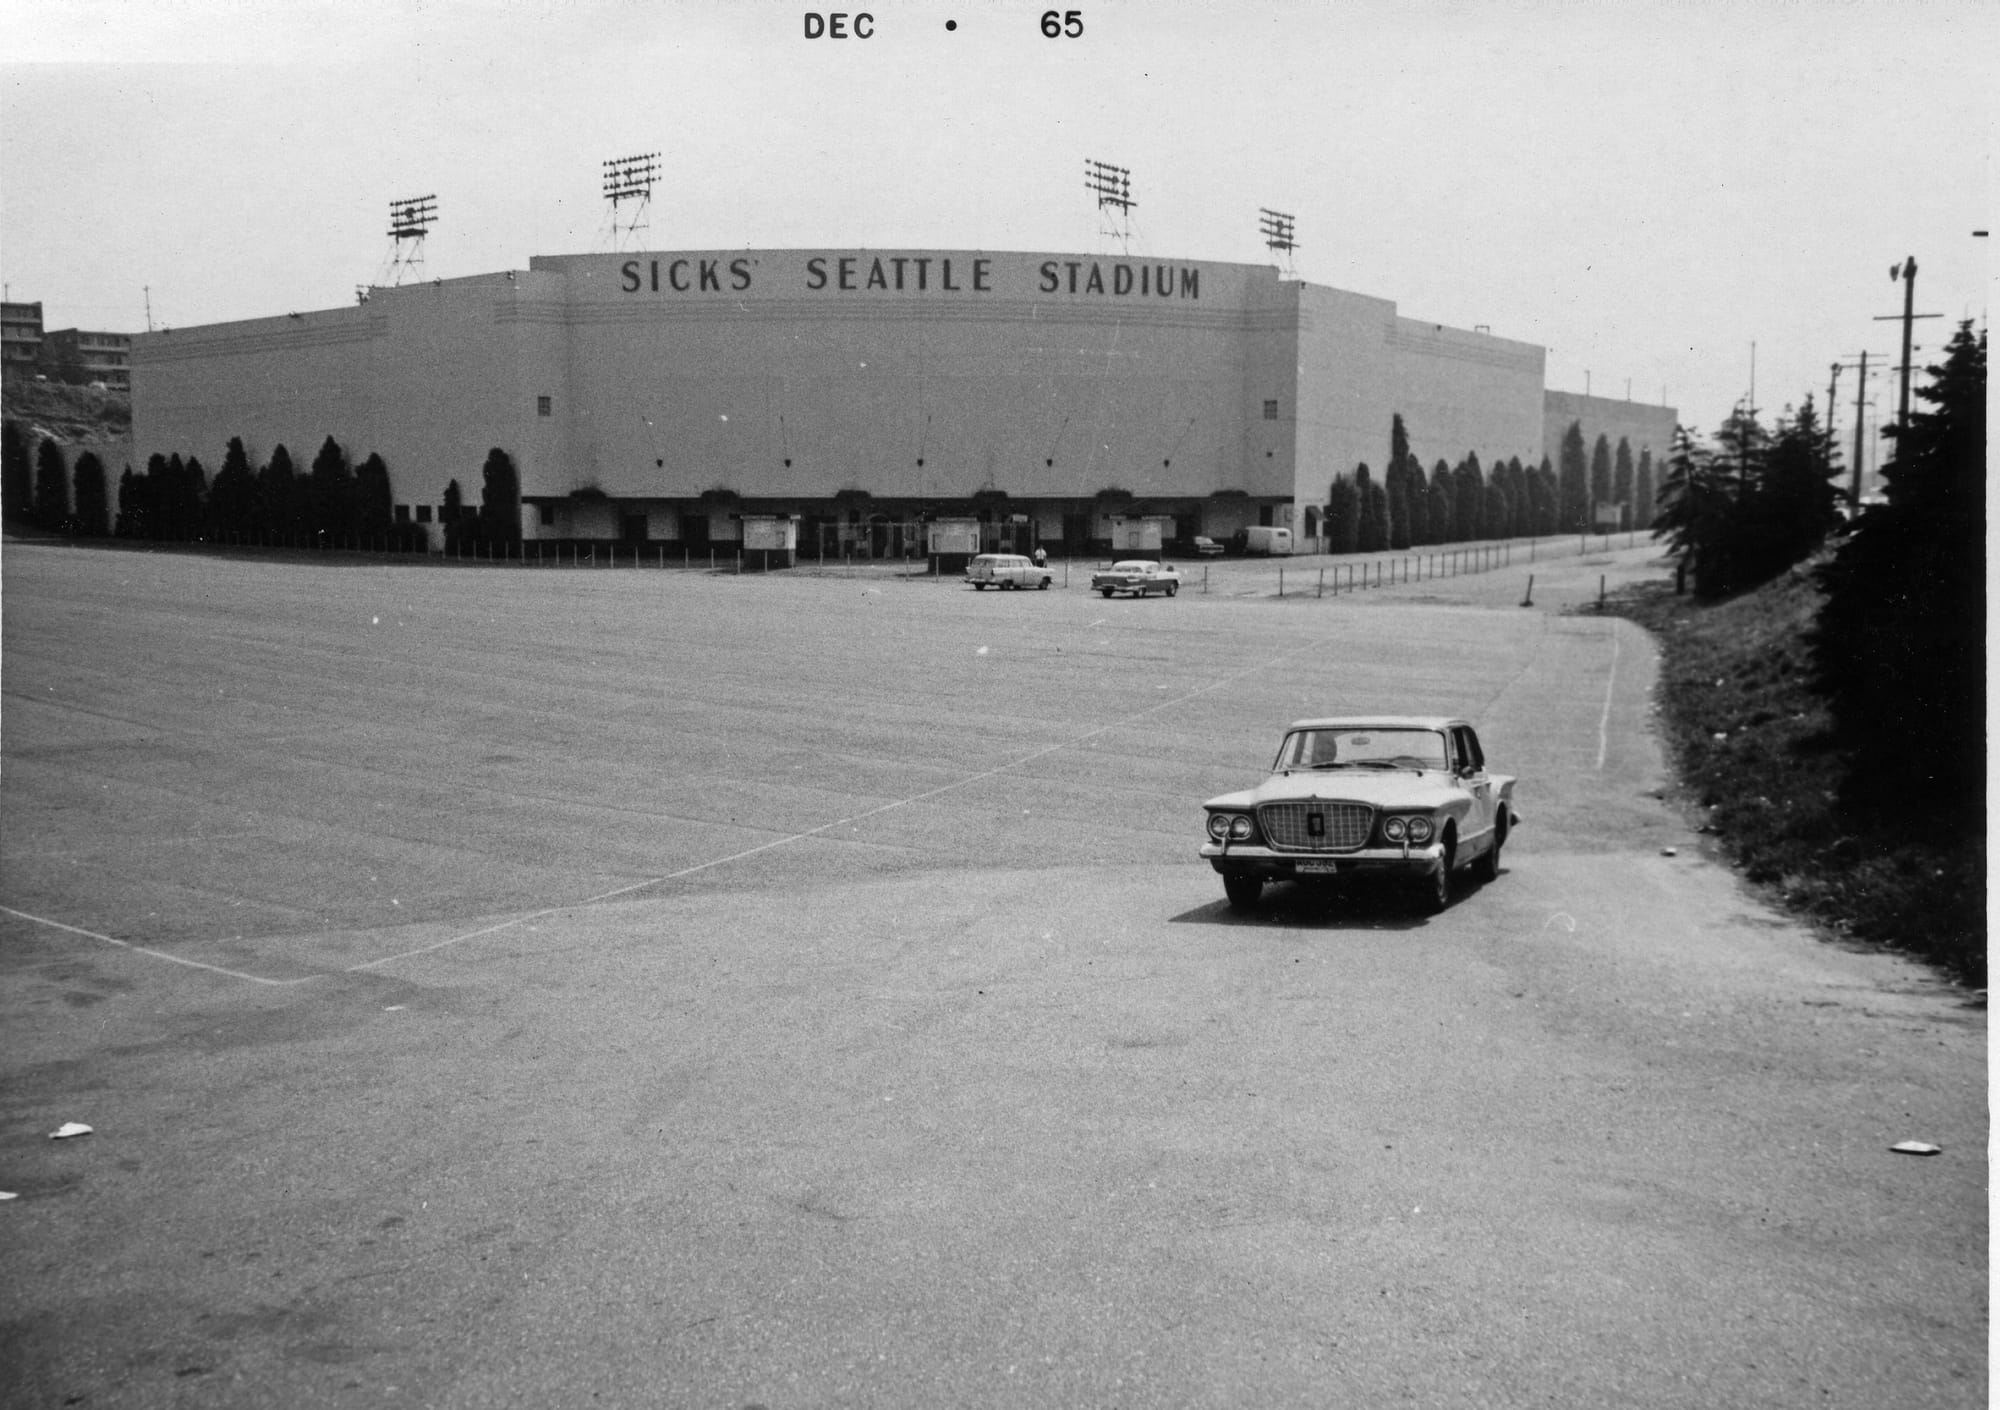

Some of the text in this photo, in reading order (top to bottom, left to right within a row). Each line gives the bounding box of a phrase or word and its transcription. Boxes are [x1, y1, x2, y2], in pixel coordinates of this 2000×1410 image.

[621, 256, 1199, 299] SICKS' SEATTLE STADIUM
